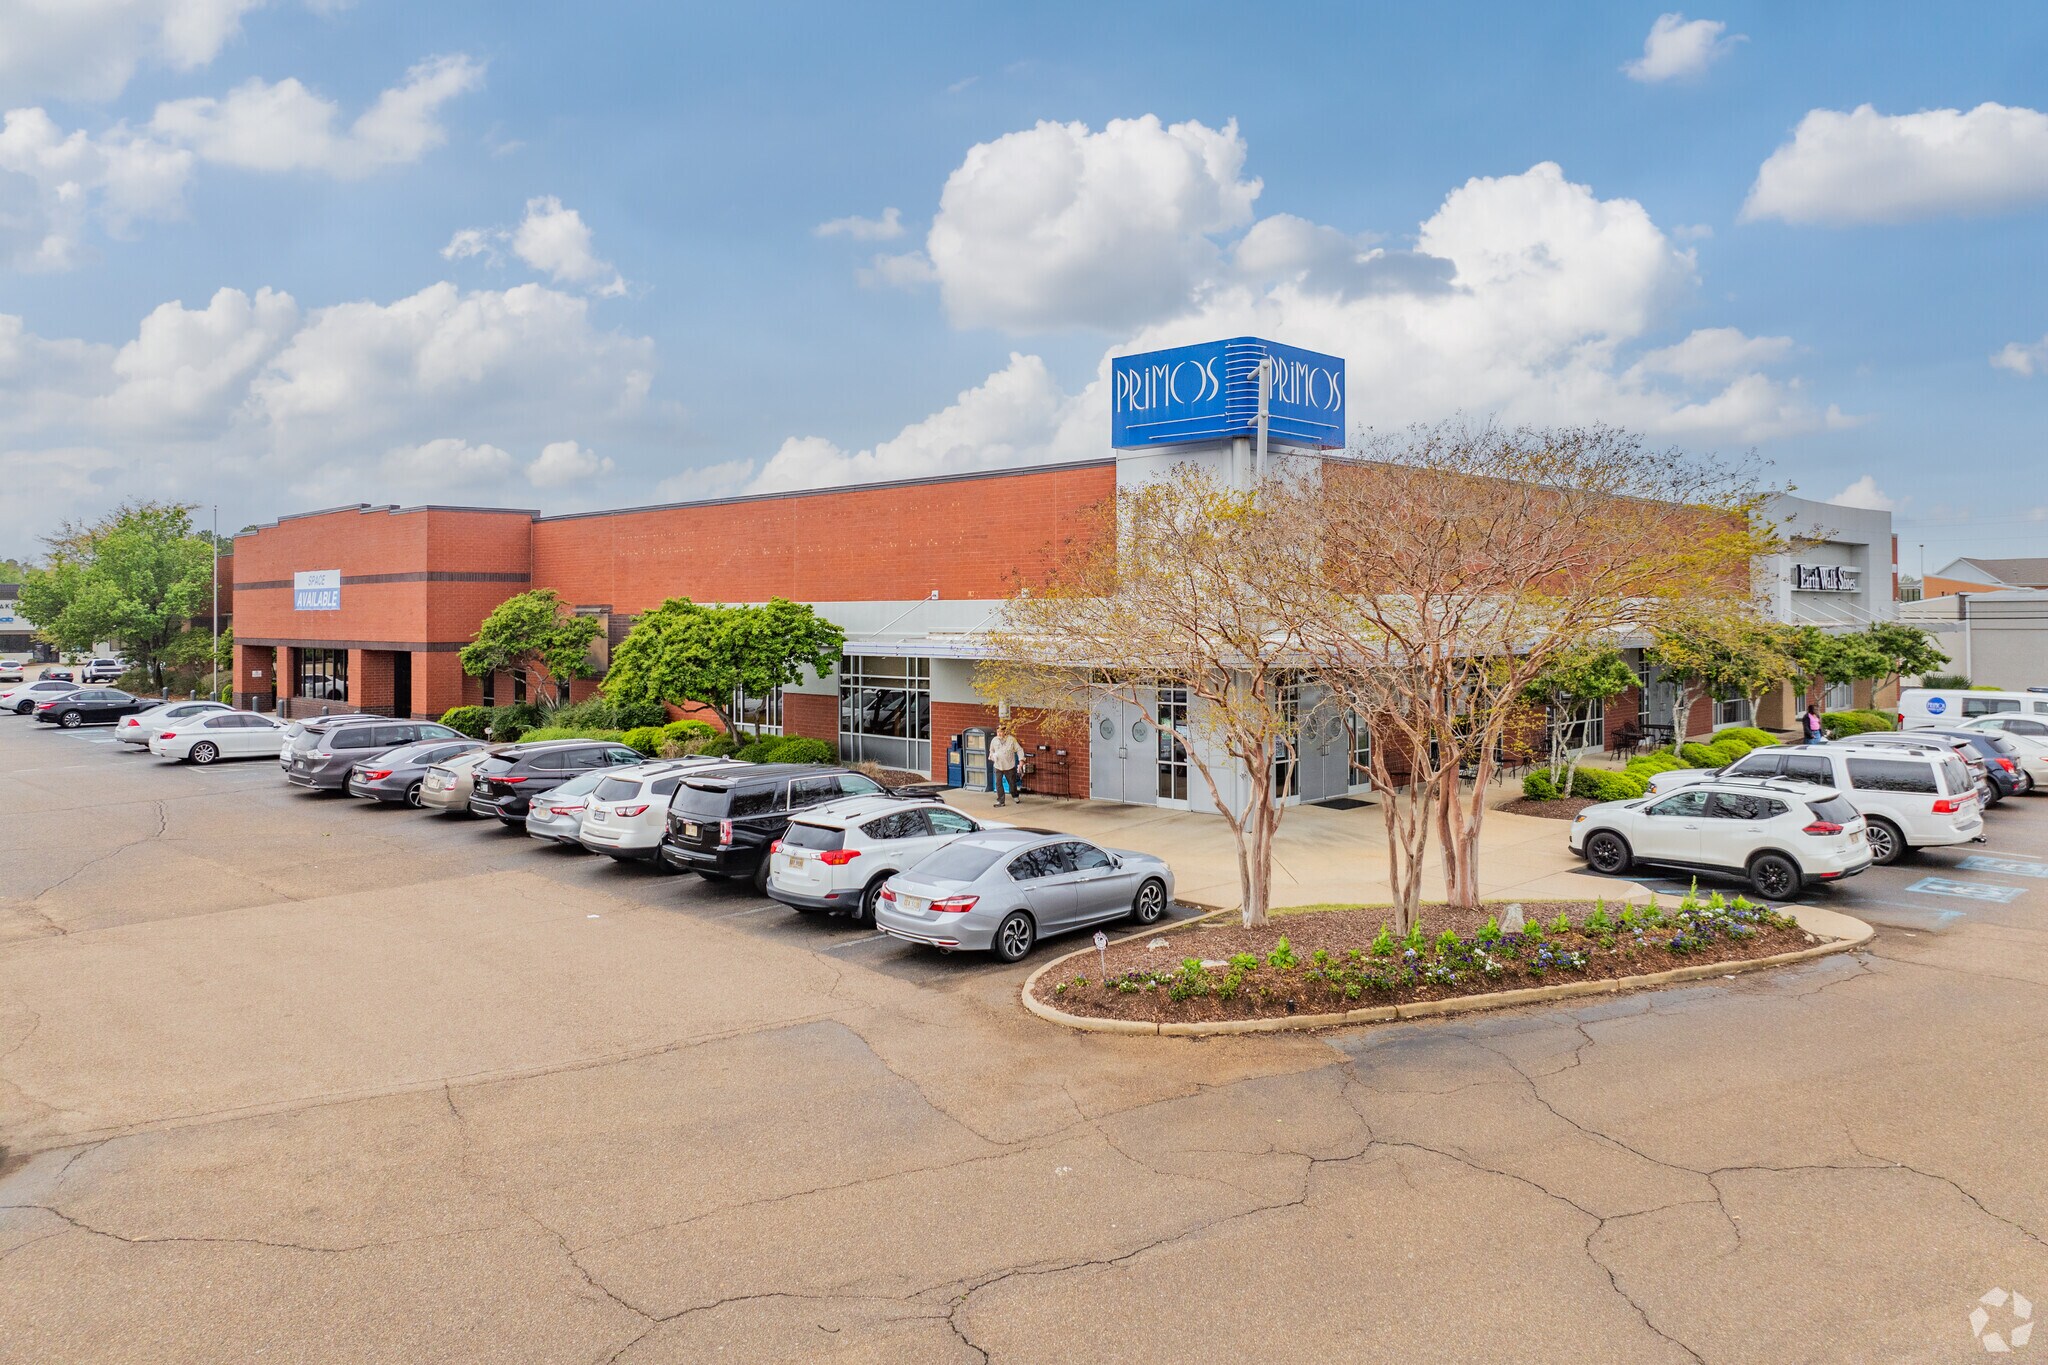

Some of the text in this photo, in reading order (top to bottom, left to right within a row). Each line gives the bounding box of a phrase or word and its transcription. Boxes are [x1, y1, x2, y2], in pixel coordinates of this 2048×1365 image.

[308, 574, 325, 586] SPACE
[1798, 564, 1856, 590] Earth Walk Shoes
[296, 590, 338, 607] AVAILABLE
